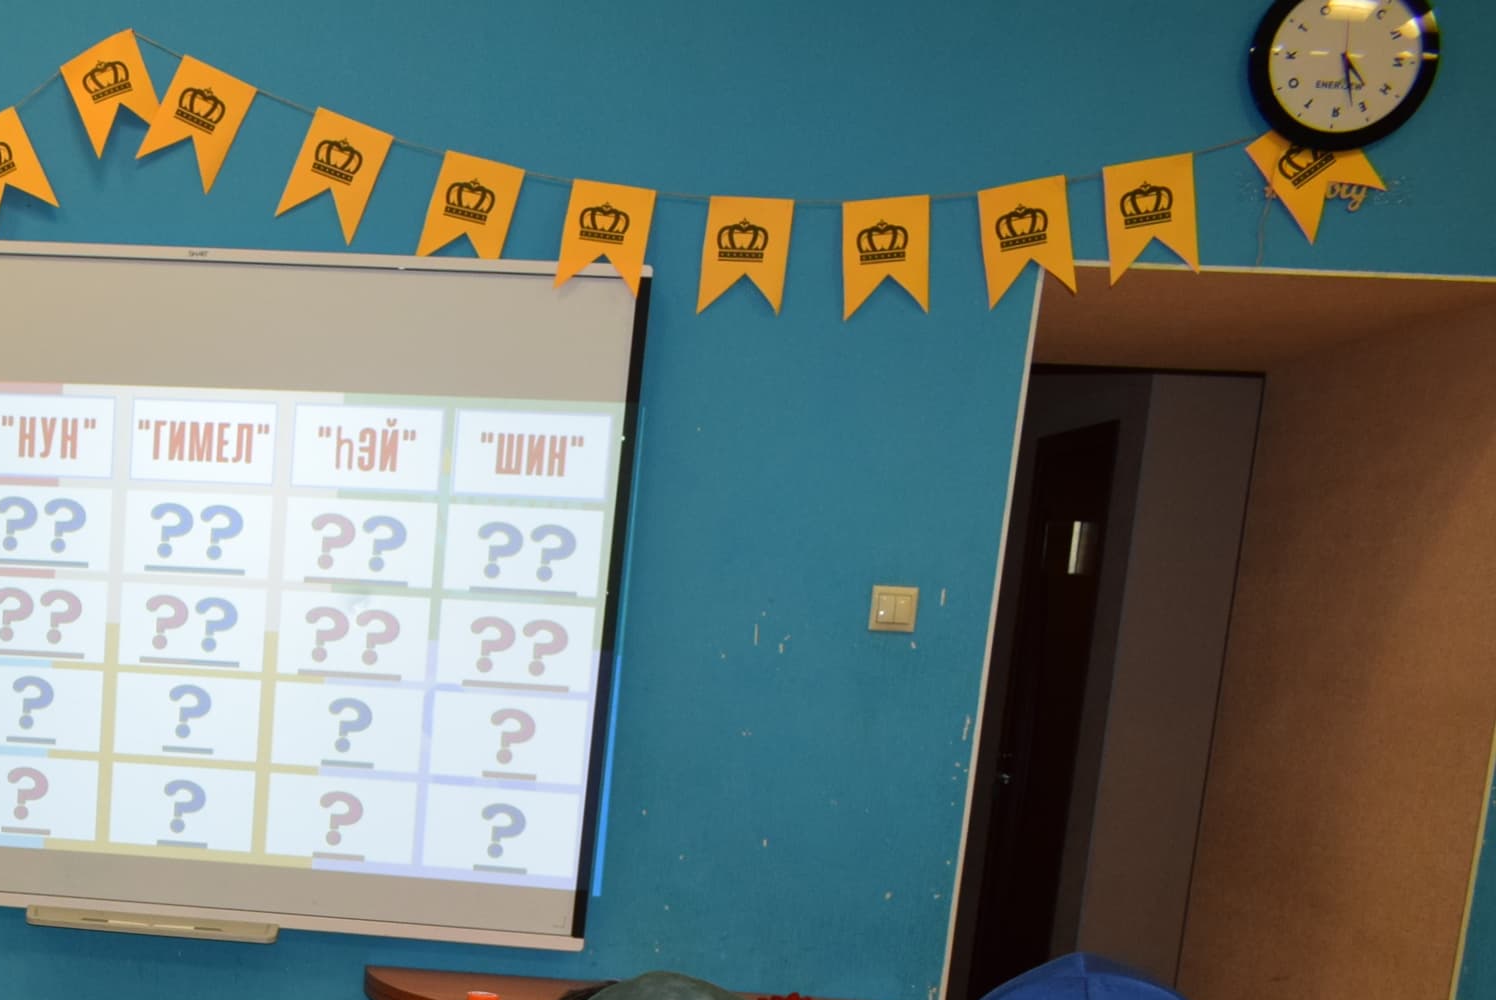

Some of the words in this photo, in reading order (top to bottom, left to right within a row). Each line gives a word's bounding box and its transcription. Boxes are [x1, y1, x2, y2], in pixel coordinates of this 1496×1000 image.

[1, 415, 98, 461] "НУН"
[138, 419, 270, 464] "ГИМЕЛ"
[481, 431, 585, 478] "ШИН"
